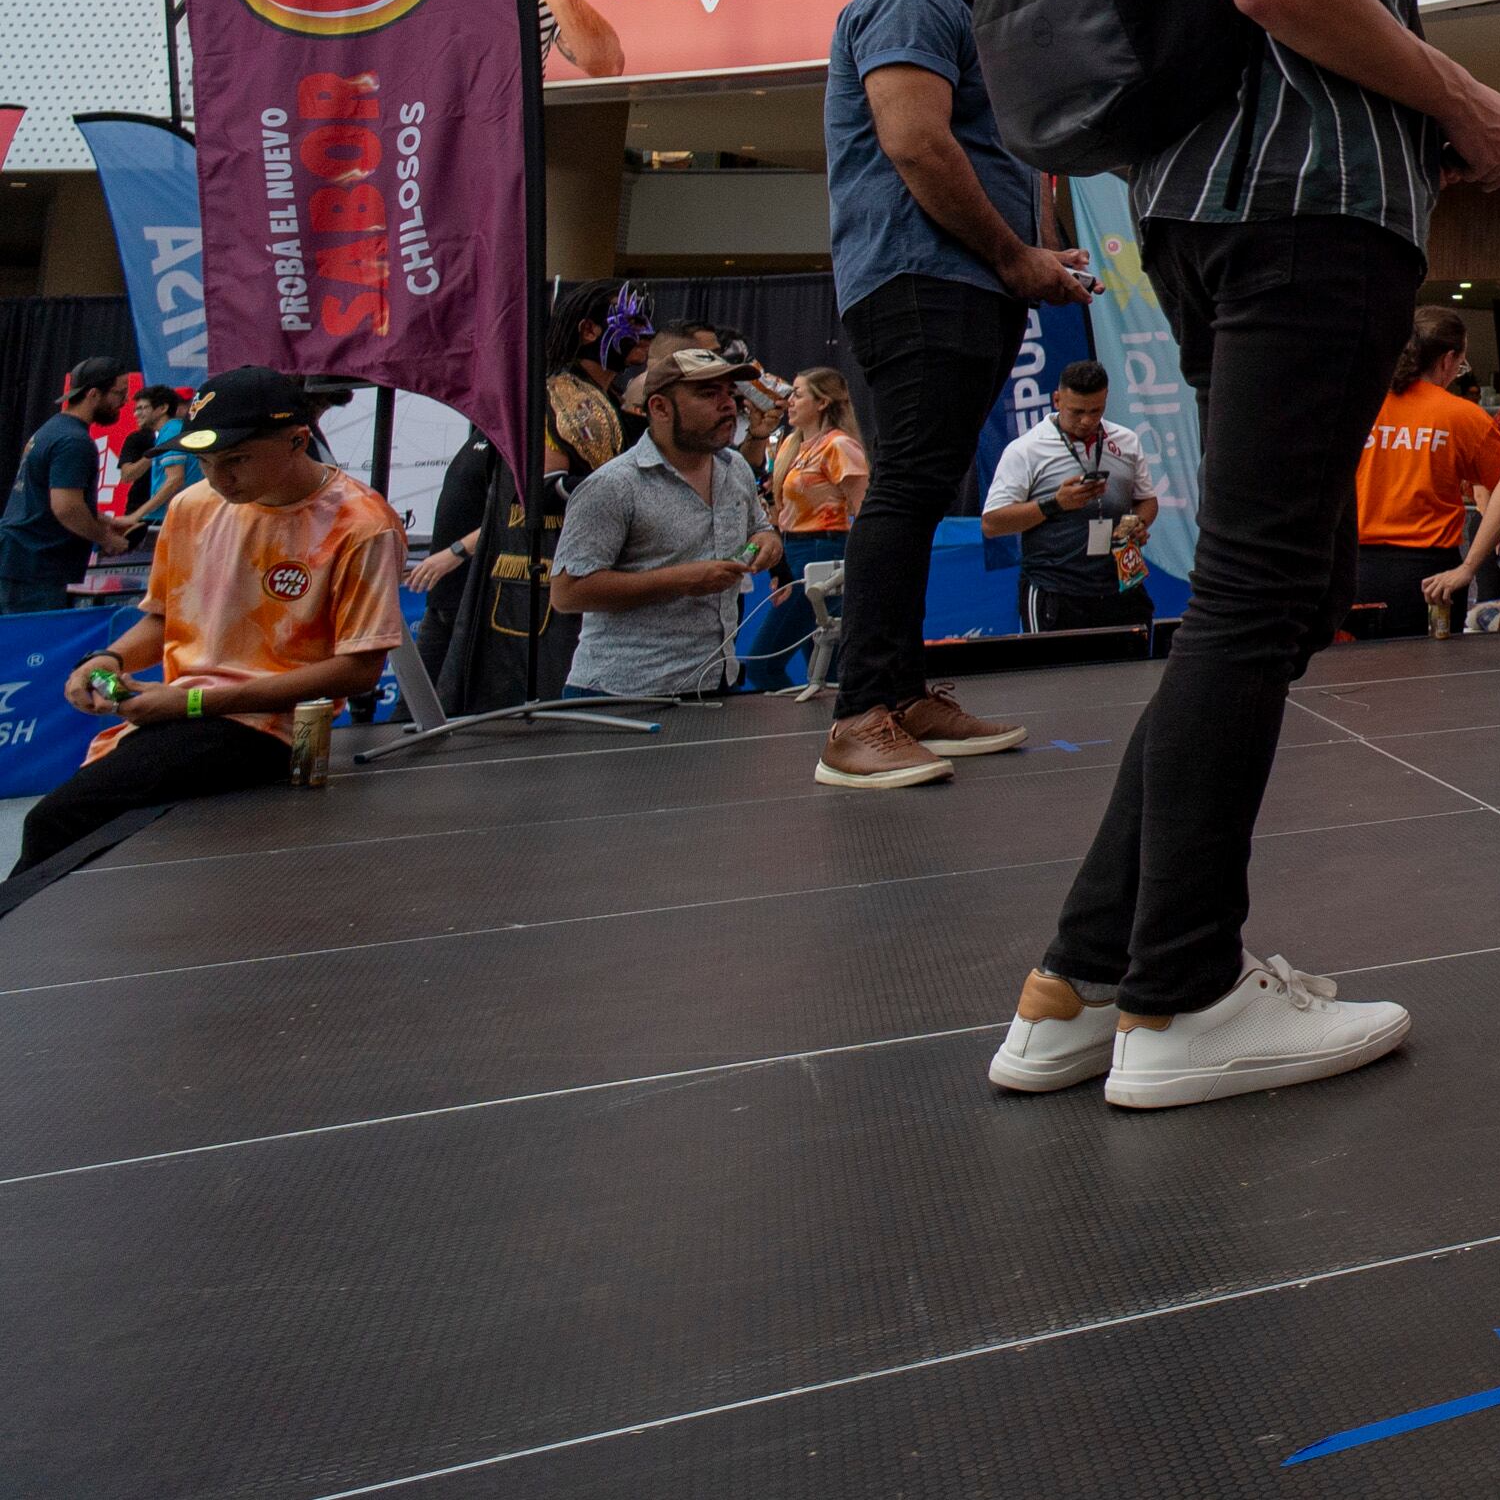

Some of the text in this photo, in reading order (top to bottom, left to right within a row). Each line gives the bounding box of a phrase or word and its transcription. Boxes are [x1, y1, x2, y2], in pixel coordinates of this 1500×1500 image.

[261, 107, 312, 332] PROBÁ EL NUEVO
[297, 69, 391, 337] SABOR
[396, 100, 440, 296] CHILOSOS
